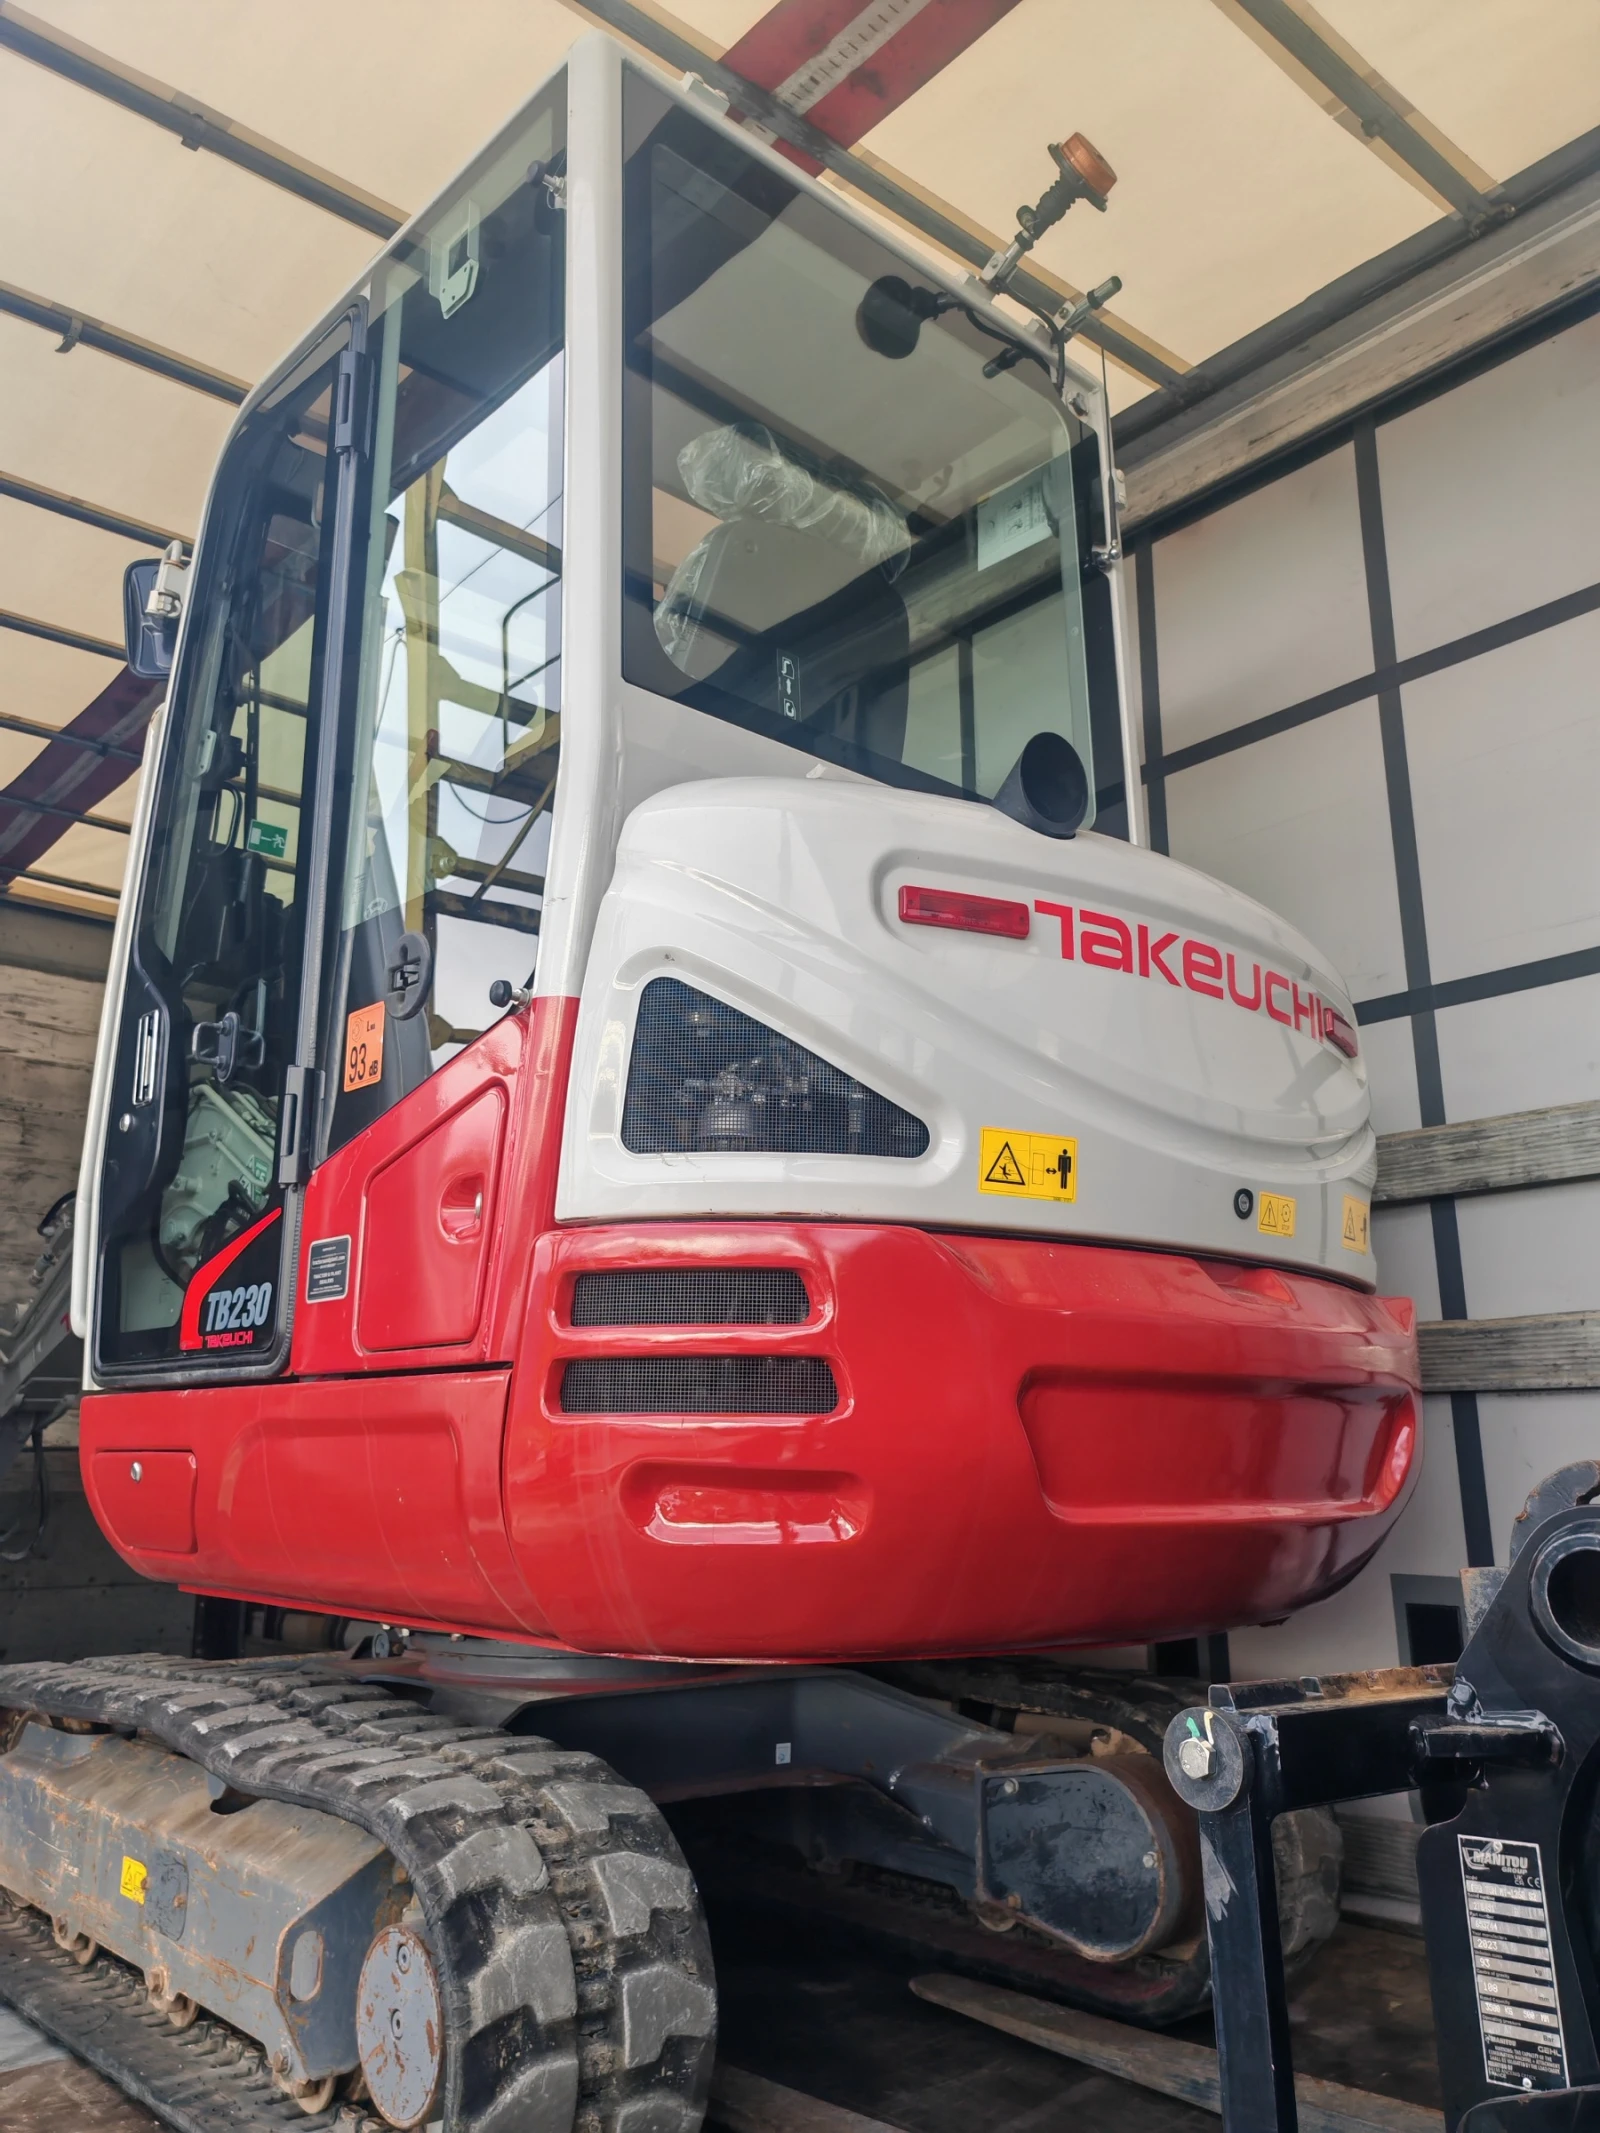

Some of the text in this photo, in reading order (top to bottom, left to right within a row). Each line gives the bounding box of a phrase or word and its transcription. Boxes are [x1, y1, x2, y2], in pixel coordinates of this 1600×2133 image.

[1034, 900, 1325, 1044] TAKEUCHI
[349, 1043, 378, 1084] 93 dB
[206, 1282, 272, 1332] TB230
[205, 1331, 253, 1348] TAKEUCHI
[1473, 1851, 1528, 1868] MANITOU
[1477, 1939, 1497, 1949] 2023
[1538, 2046, 1562, 2056] GEHL
